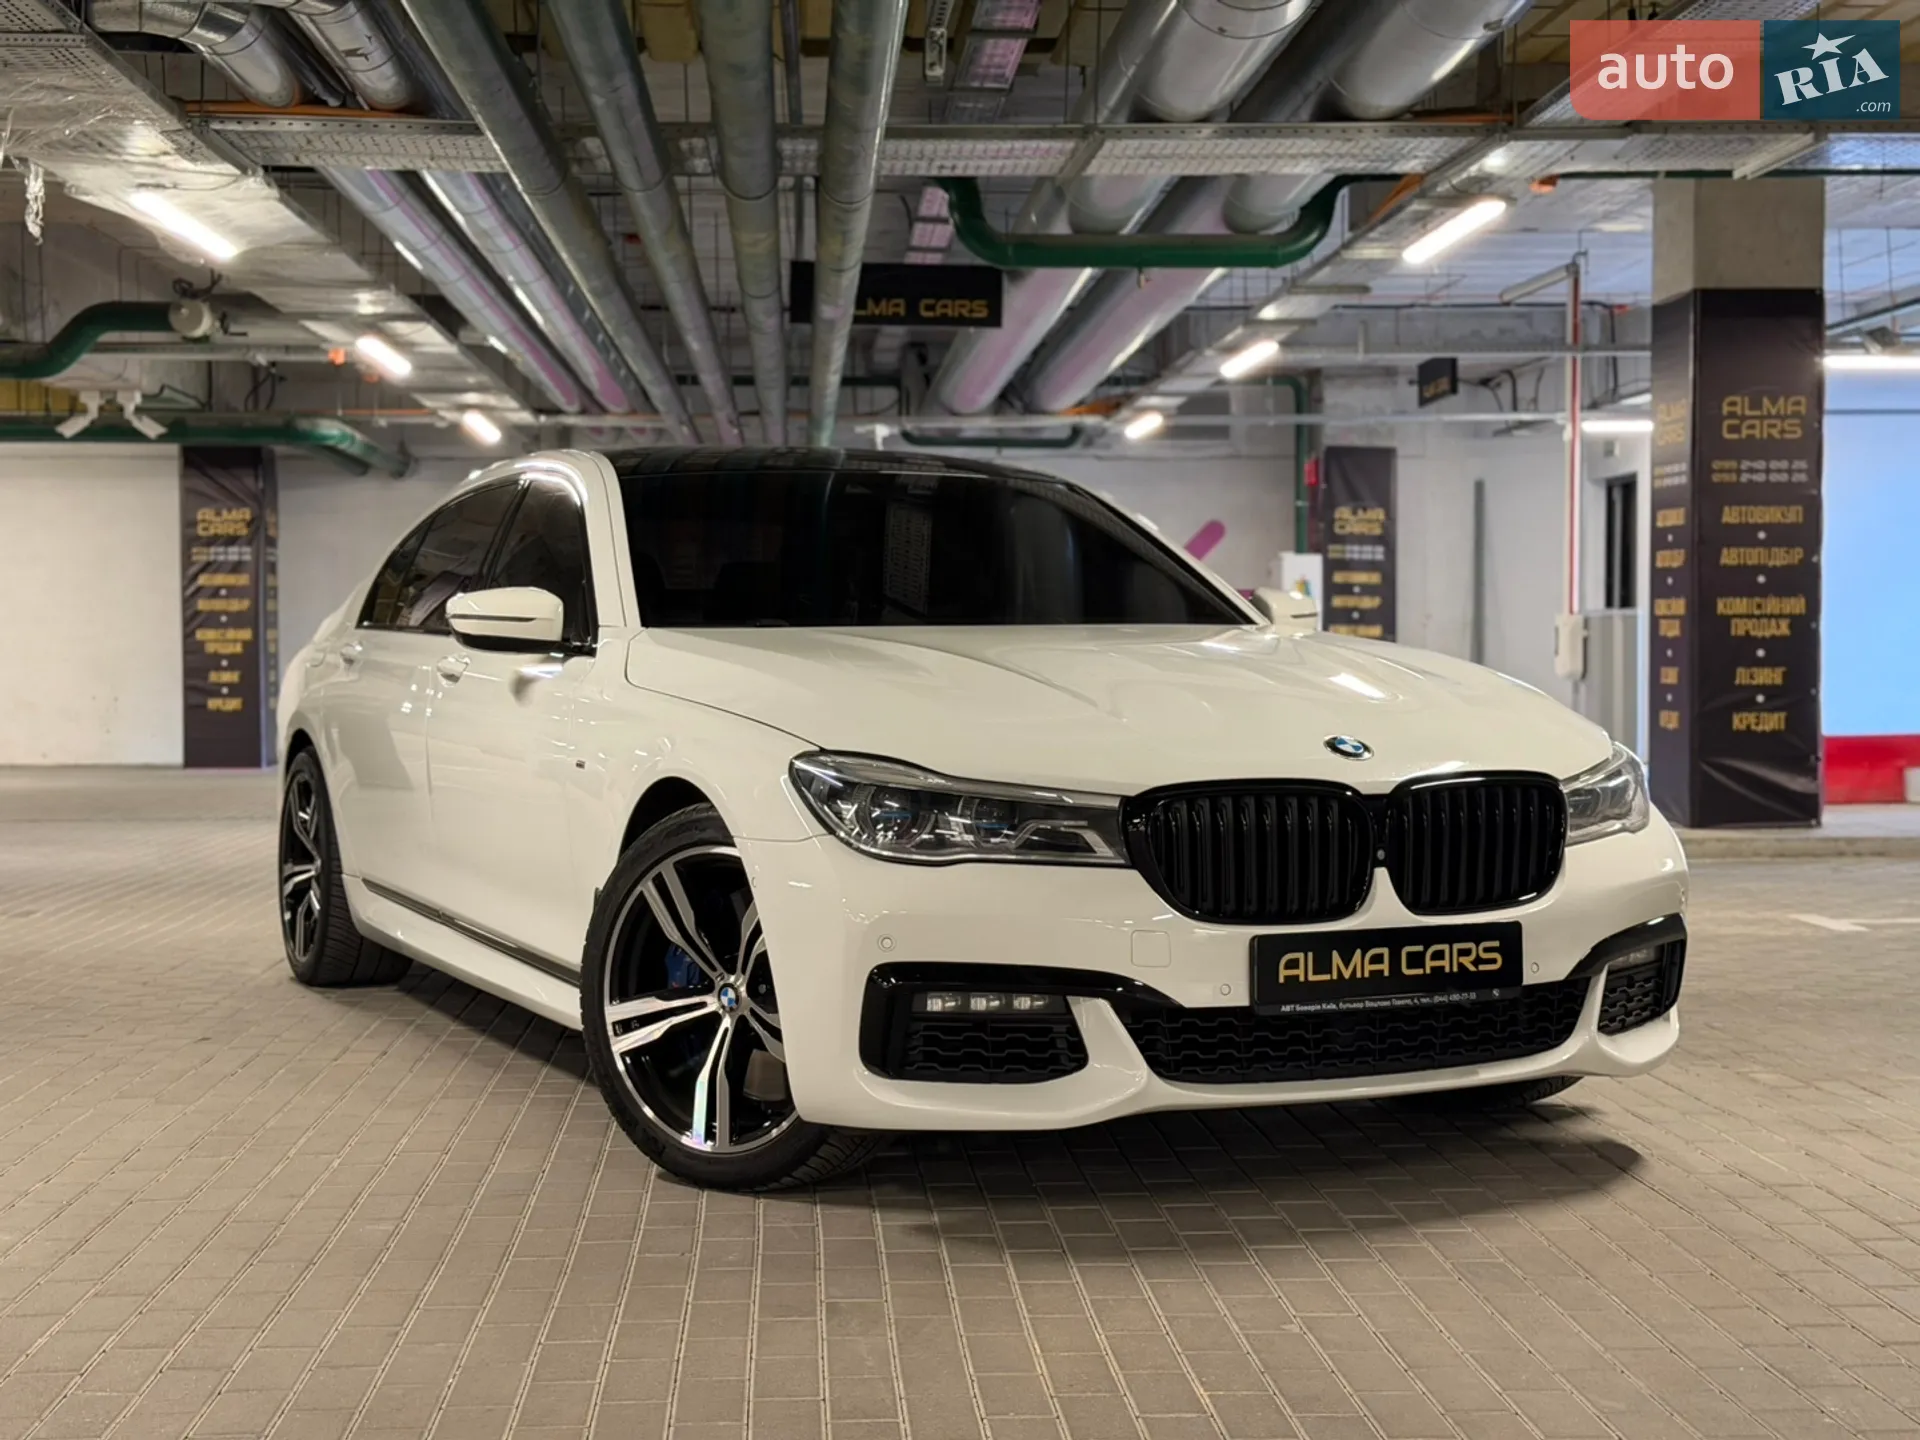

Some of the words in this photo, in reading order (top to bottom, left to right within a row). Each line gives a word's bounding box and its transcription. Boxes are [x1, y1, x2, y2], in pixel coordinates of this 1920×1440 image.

[855, 299, 905, 316] MA
[919, 300, 988, 318] CARS
[1721, 396, 1807, 416] ALMA
[1721, 419, 1802, 439] CARS
[196, 508, 251, 521] ALMA
[1722, 505, 1803, 524] АВТОВИКУП
[196, 522, 249, 536] CARS
[1720, 546, 1804, 567] АВТОПІДБІР
[1717, 594, 1805, 616] КОМІСІЙНИЙ
[1730, 618, 1790, 638] ПРОДАЖ
[1734, 666, 1786, 685] ЛІЗИНГ
[1732, 711, 1787, 732] КРЕДИТ
[1278, 947, 1389, 984] ALMA
[1401, 940, 1503, 975] CARS
